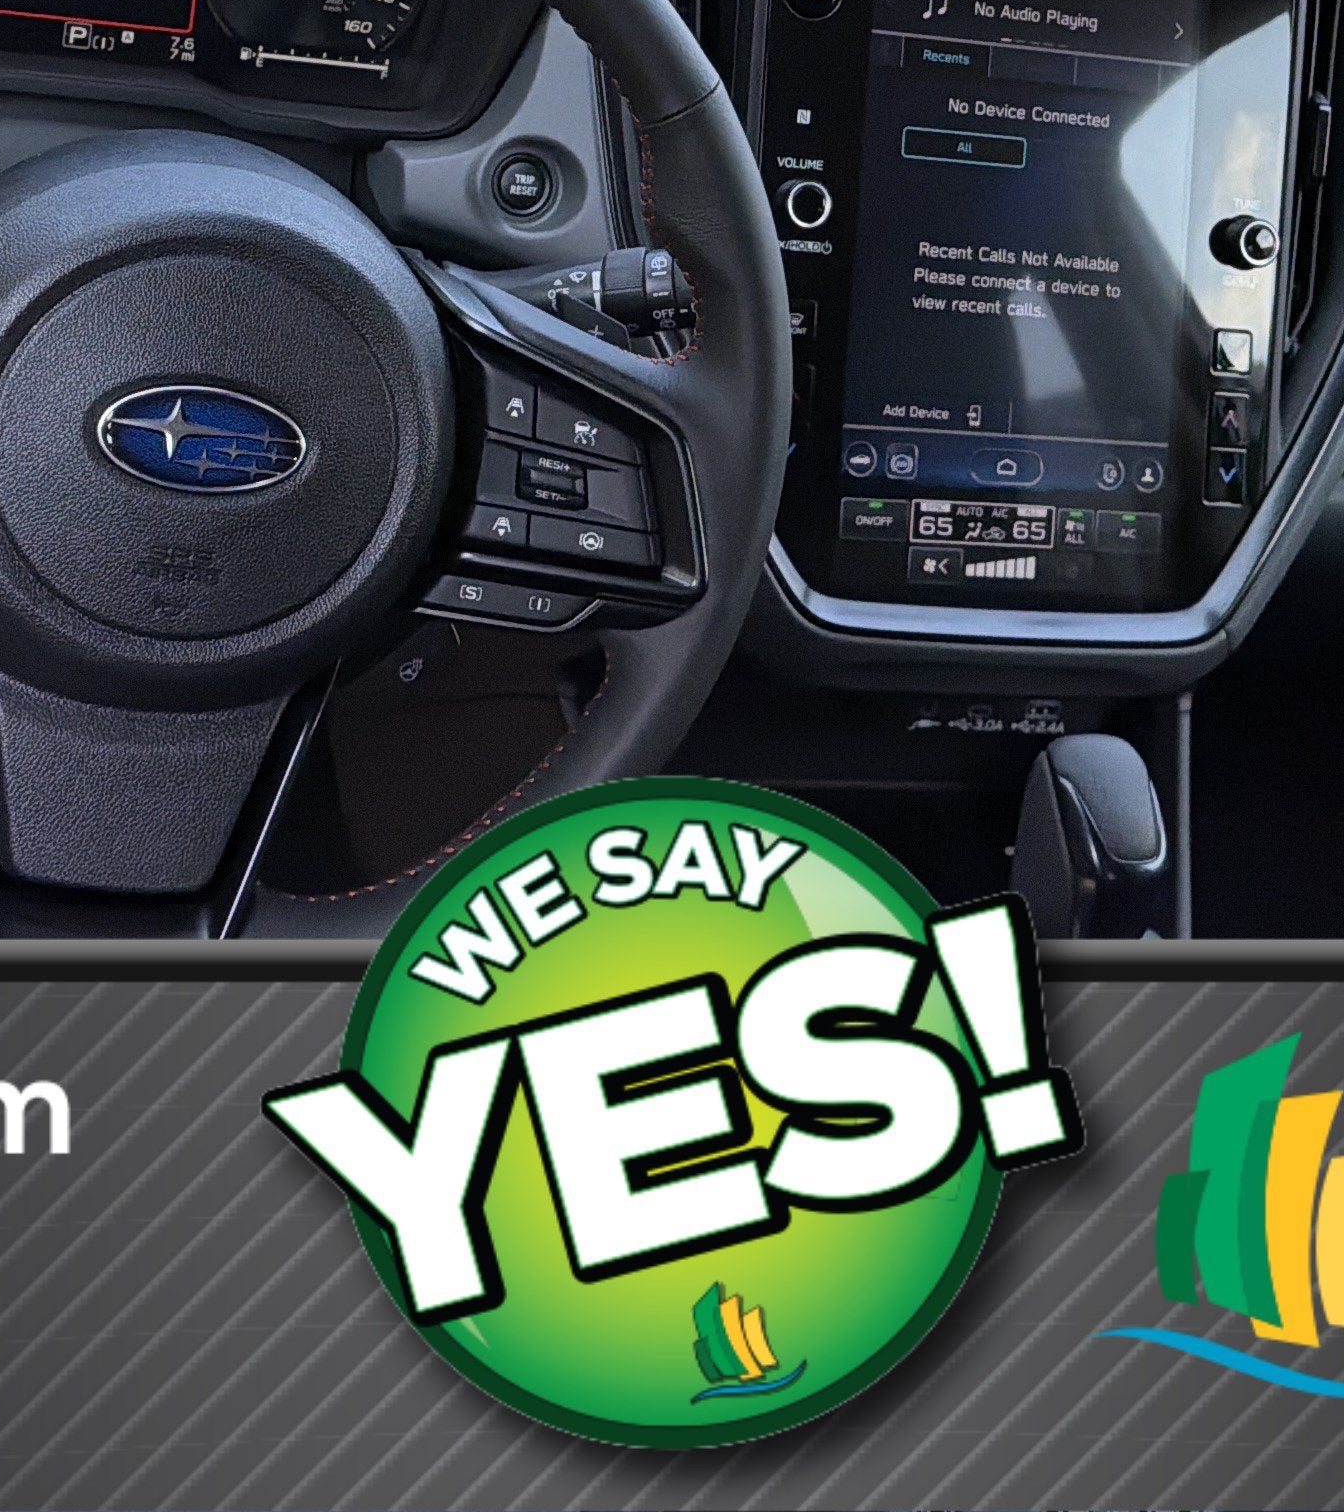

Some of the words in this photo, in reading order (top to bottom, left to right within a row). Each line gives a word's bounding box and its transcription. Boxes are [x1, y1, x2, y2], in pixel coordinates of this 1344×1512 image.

[974, 1, 995, 19] No
[1000, 4, 1040, 24] Audio
[1046, 10, 1098, 32] Playing
[344, 20, 373, 34] 160
[68, 25, 88, 45] P
[170, 35, 195, 50] 7.6
[169, 48, 180, 61] 7
[181, 50, 195, 62] mi
[923, 50, 970, 66] Recents
[949, 98, 968, 116] No
[974, 100, 1026, 121] Device
[1031, 106, 1110, 129] Connected
[957, 140, 973, 154] All
[777, 156, 824, 171] VOLUME
[514, 173, 536, 186] TRIP
[509, 183, 538, 197] RESET
[918, 241, 973, 261] Recent
[978, 246, 1016, 264] Calls
[1021, 251, 1049, 267] Not
[1054, 253, 1120, 273] Available
[913, 267, 965, 286] Please
[971, 273, 1032, 291] connect
[1037, 280, 1046, 293] a
[1051, 278, 1100, 297] device
[1105, 283, 1121, 298] to
[912, 294, 946, 312] view
[951, 297, 1002, 315] recent
[1007, 300, 1047, 319] calls.
[652, 309, 676, 320] OFF
[883, 404, 905, 418] Add
[910, 407, 949, 421] Device
[956, 506, 984, 518] AUTO
[991, 508, 1009, 519] A/C
[918, 516, 954, 536] 65
[1012, 520, 1047, 541] 65
[1119, 528, 1137, 539] A/C
[1064, 533, 1085, 545] ALL
